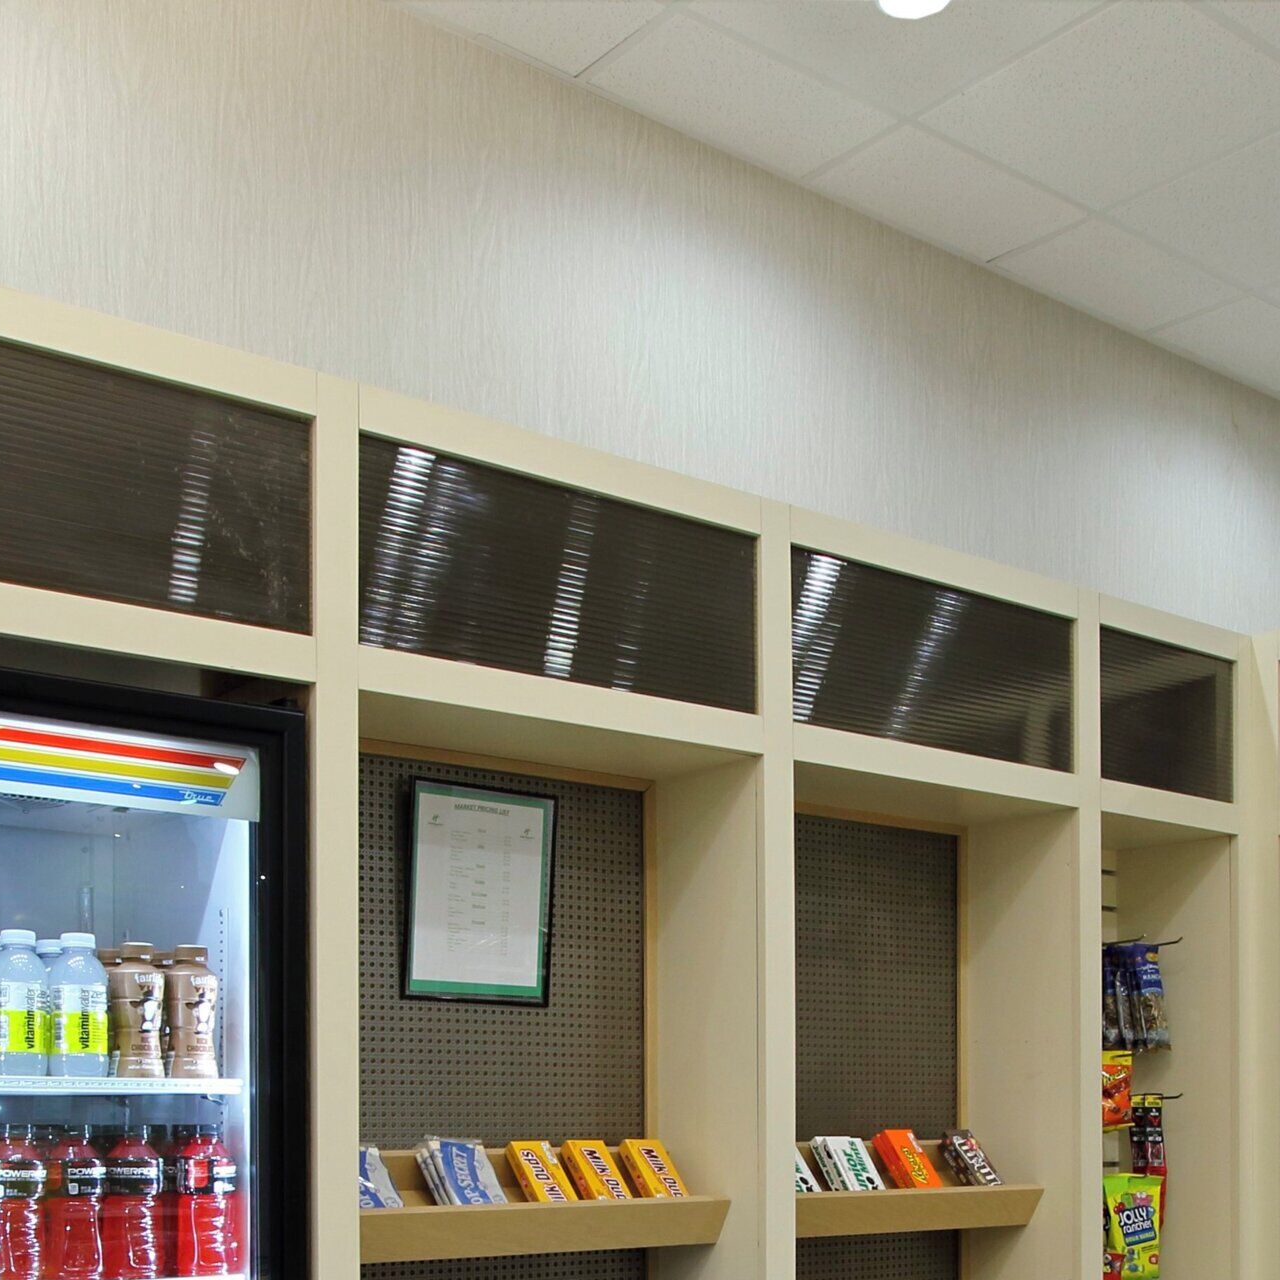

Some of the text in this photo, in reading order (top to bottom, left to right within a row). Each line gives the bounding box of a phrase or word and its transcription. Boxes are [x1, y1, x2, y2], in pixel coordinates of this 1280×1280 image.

[454, 803, 476, 811] MARKET
[477, 806, 498, 814] PRICING
[452, 1146, 475, 1189] SECRET
[581, 1147, 613, 1175] Milk
[639, 1146, 669, 1174] Milk
[1120, 1207, 1146, 1226] JOLLY
